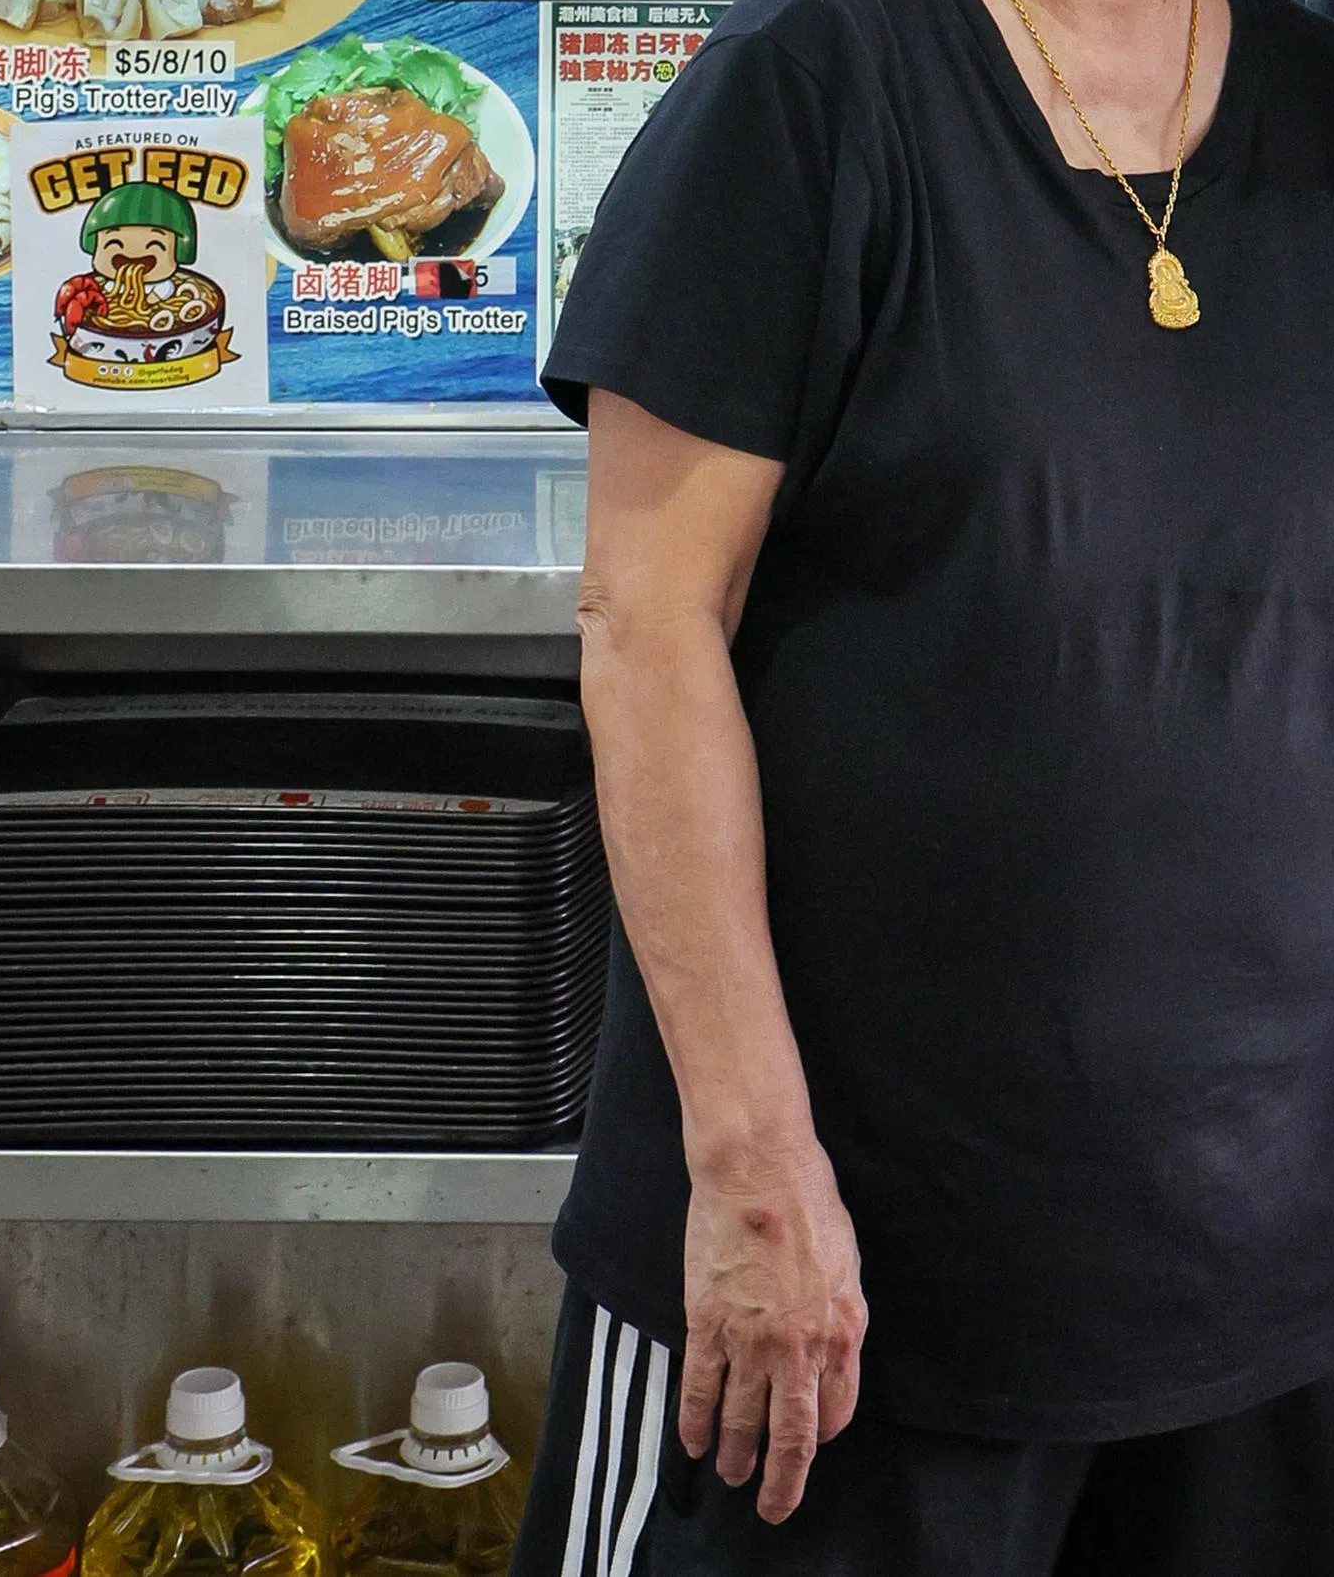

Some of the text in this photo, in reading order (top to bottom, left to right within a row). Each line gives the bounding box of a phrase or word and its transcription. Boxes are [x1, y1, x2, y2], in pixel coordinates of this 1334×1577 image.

[559, 32, 629, 55] 猪脚冻
[114, 47, 228, 77] $5/8/10
[15, 85, 236, 115] Pig's Trotter Jelly
[75, 132, 199, 150] AS FEATURED ON
[30, 147, 248, 212] GET FED
[292, 262, 400, 300] 卤猪脚
[286, 308, 524, 338] Braised Pig's Trotter
